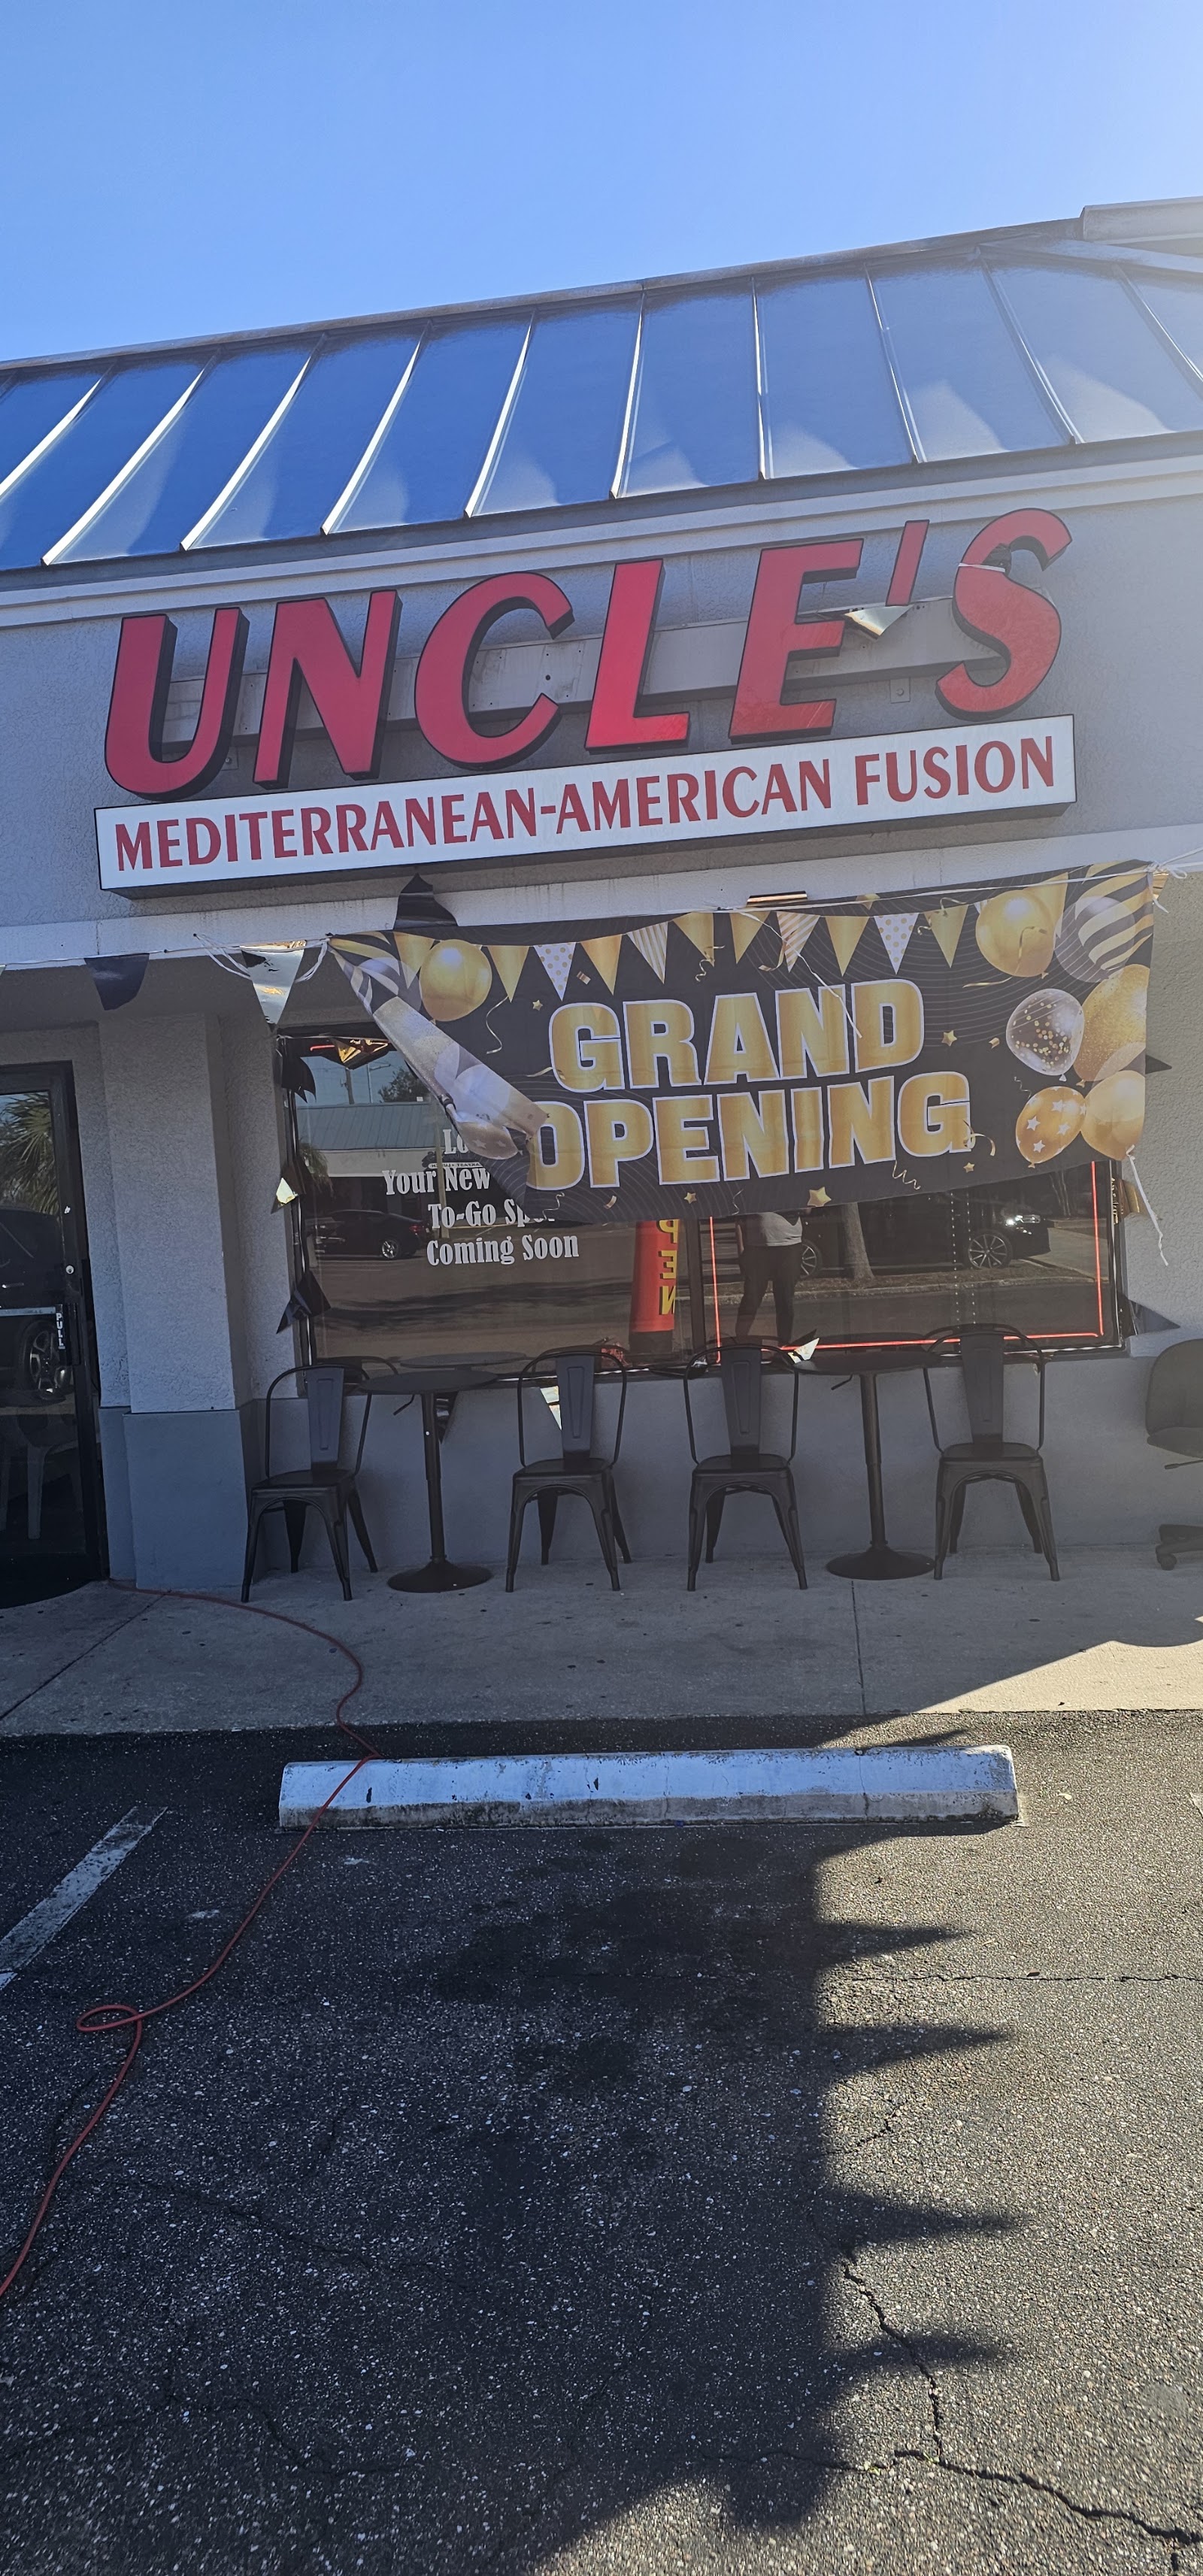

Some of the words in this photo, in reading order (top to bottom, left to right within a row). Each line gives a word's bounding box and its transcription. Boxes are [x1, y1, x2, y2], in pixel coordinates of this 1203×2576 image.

[105, 508, 1072, 799] UNCLE'S
[115, 759, 832, 871] MEDITERRANEAN-AMERICAN
[855, 735, 1054, 805] FUSION
[549, 978, 924, 1093] GRAND
[526, 1071, 972, 1191] OPENING
[382, 1170, 436, 1196] Your
[445, 1167, 490, 1192] New
[428, 1201, 496, 1229] To-Go
[504, 1199, 555, 1228] Sp
[426, 1236, 515, 1266] Coming
[522, 1234, 579, 1260] Soon
[56, 1312, 64, 1346] PULL
